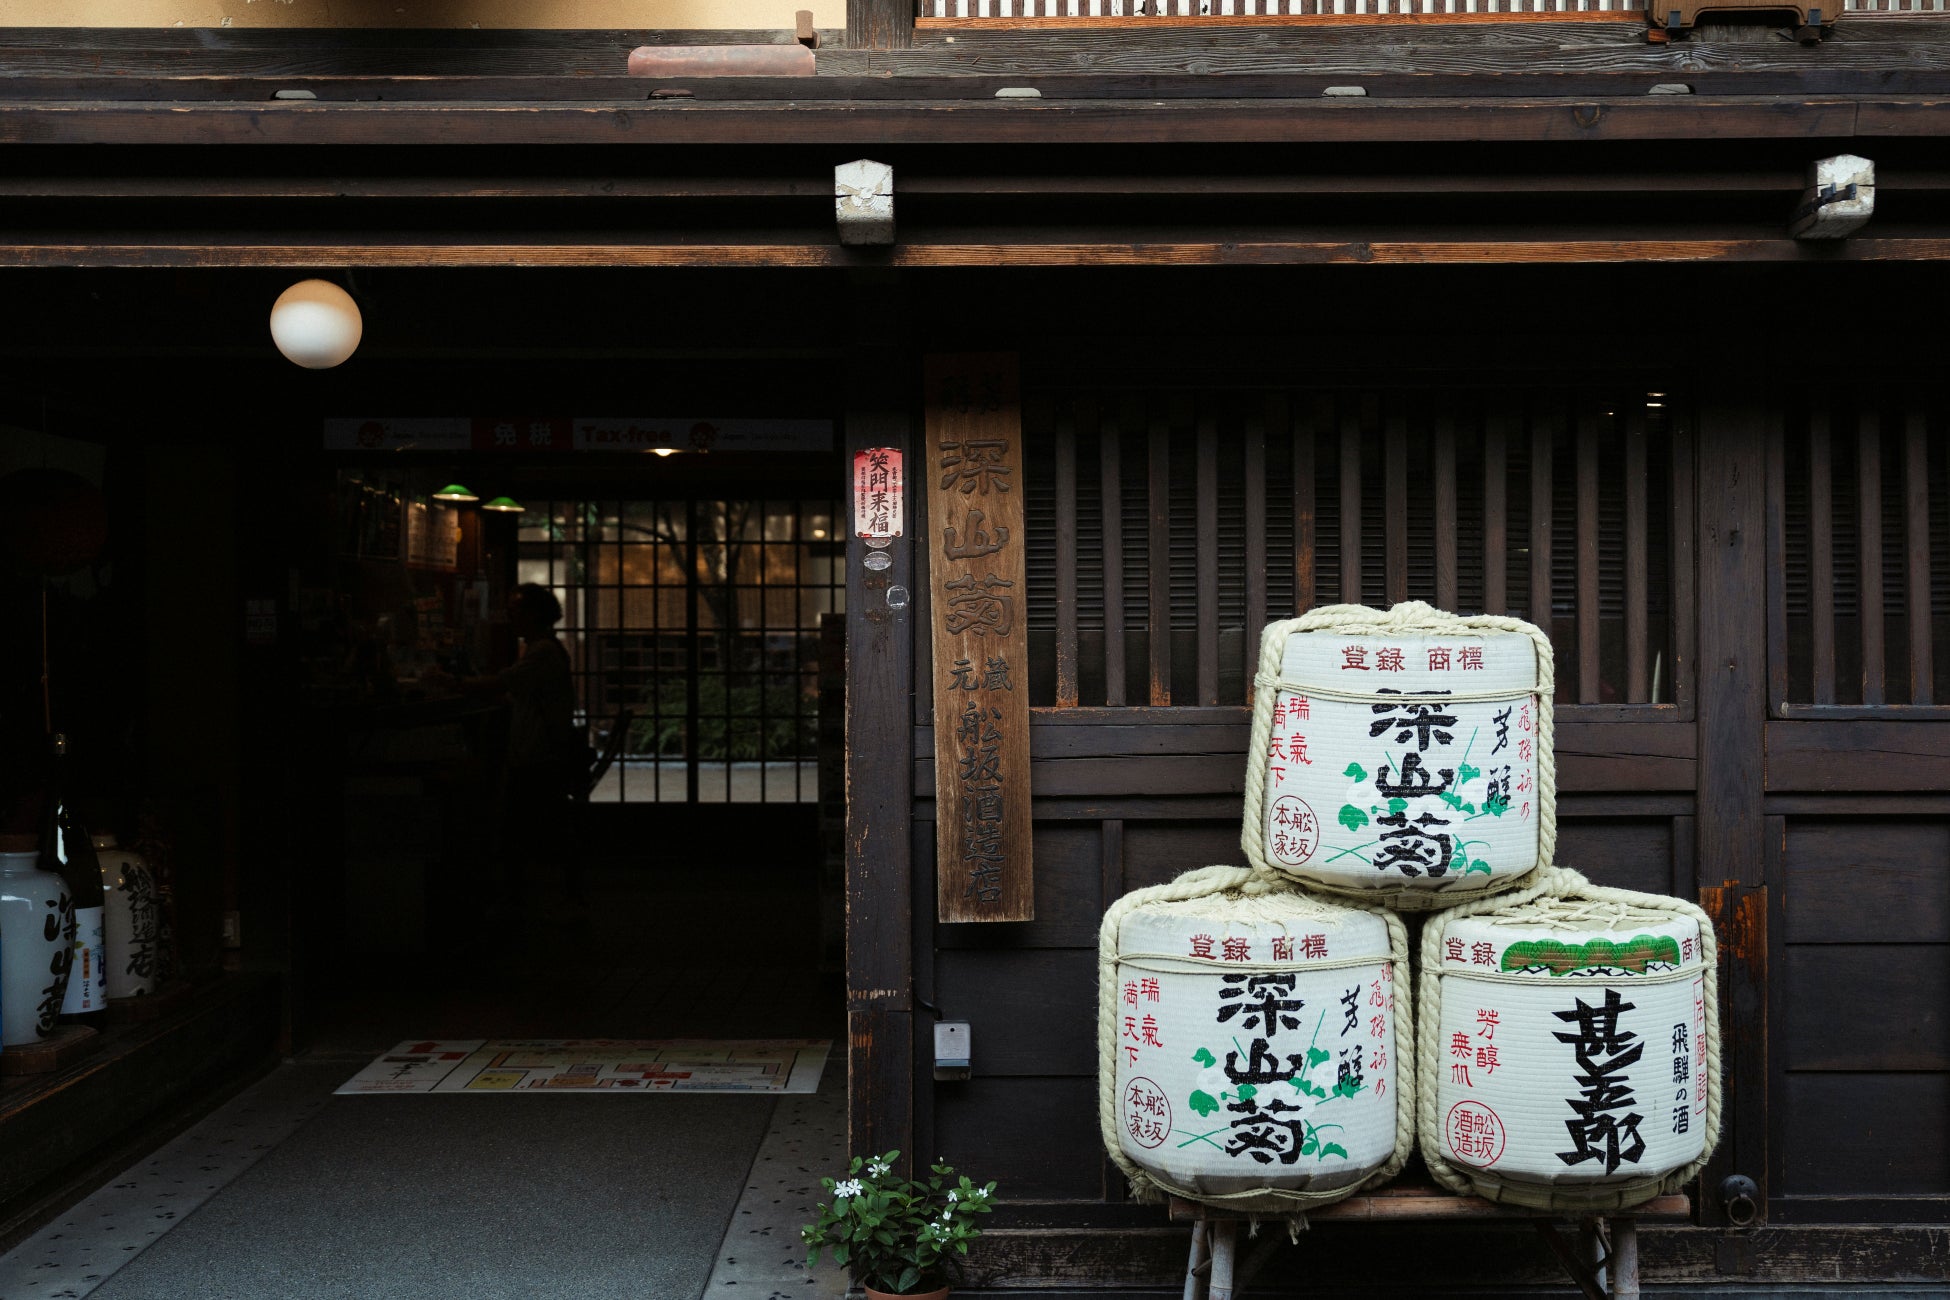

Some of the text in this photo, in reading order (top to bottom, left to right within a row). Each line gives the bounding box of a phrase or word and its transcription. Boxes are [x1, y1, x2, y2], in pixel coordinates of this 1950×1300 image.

[493, 422, 553, 447] 免税
[580, 425, 673, 443] Tax-free
[869, 452, 890, 533] 笑門来福
[939, 438, 1014, 637] 深山菊
[1341, 645, 1485, 672] 登録商標
[1369, 688, 1459, 878] 深山菊
[1188, 933, 1329, 963] 登録商標
[1216, 973, 1305, 1165] 深山菊
[1551, 987, 1647, 1177] 甚五郎
[1672, 1022, 1690, 1136] 飛騨の酒
